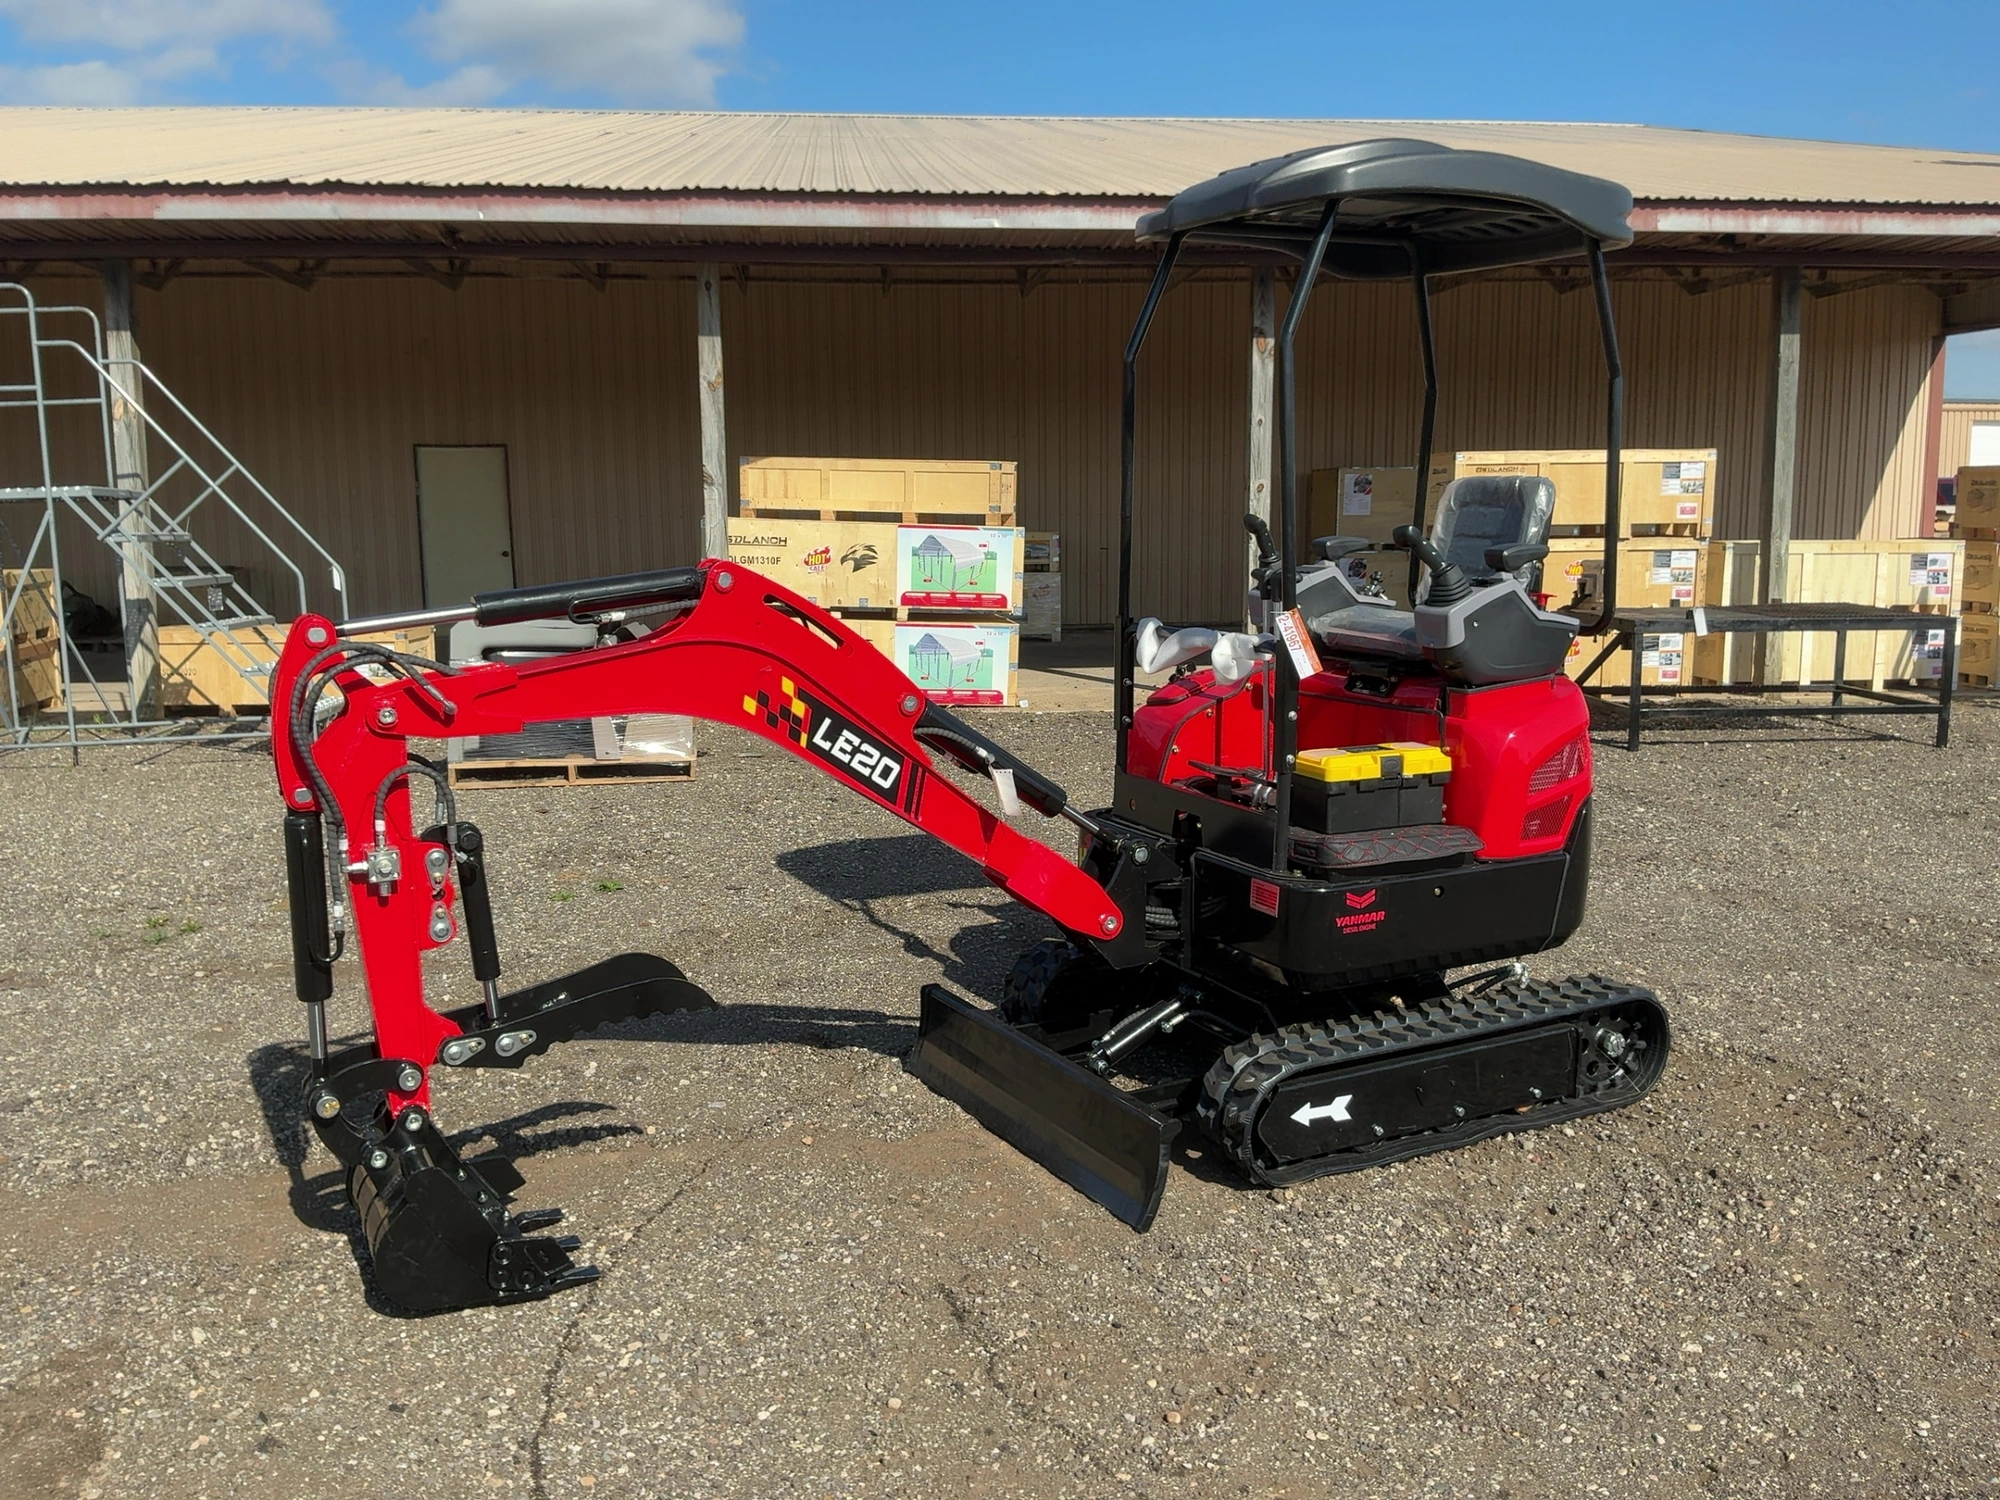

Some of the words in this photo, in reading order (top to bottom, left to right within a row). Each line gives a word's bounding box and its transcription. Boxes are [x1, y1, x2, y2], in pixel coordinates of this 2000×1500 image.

[808, 553, 826, 566] HOT
[1278, 615, 1302, 651] 2-41967
[812, 717, 901, 789] LE20
[1335, 910, 1386, 927] YANMAR
